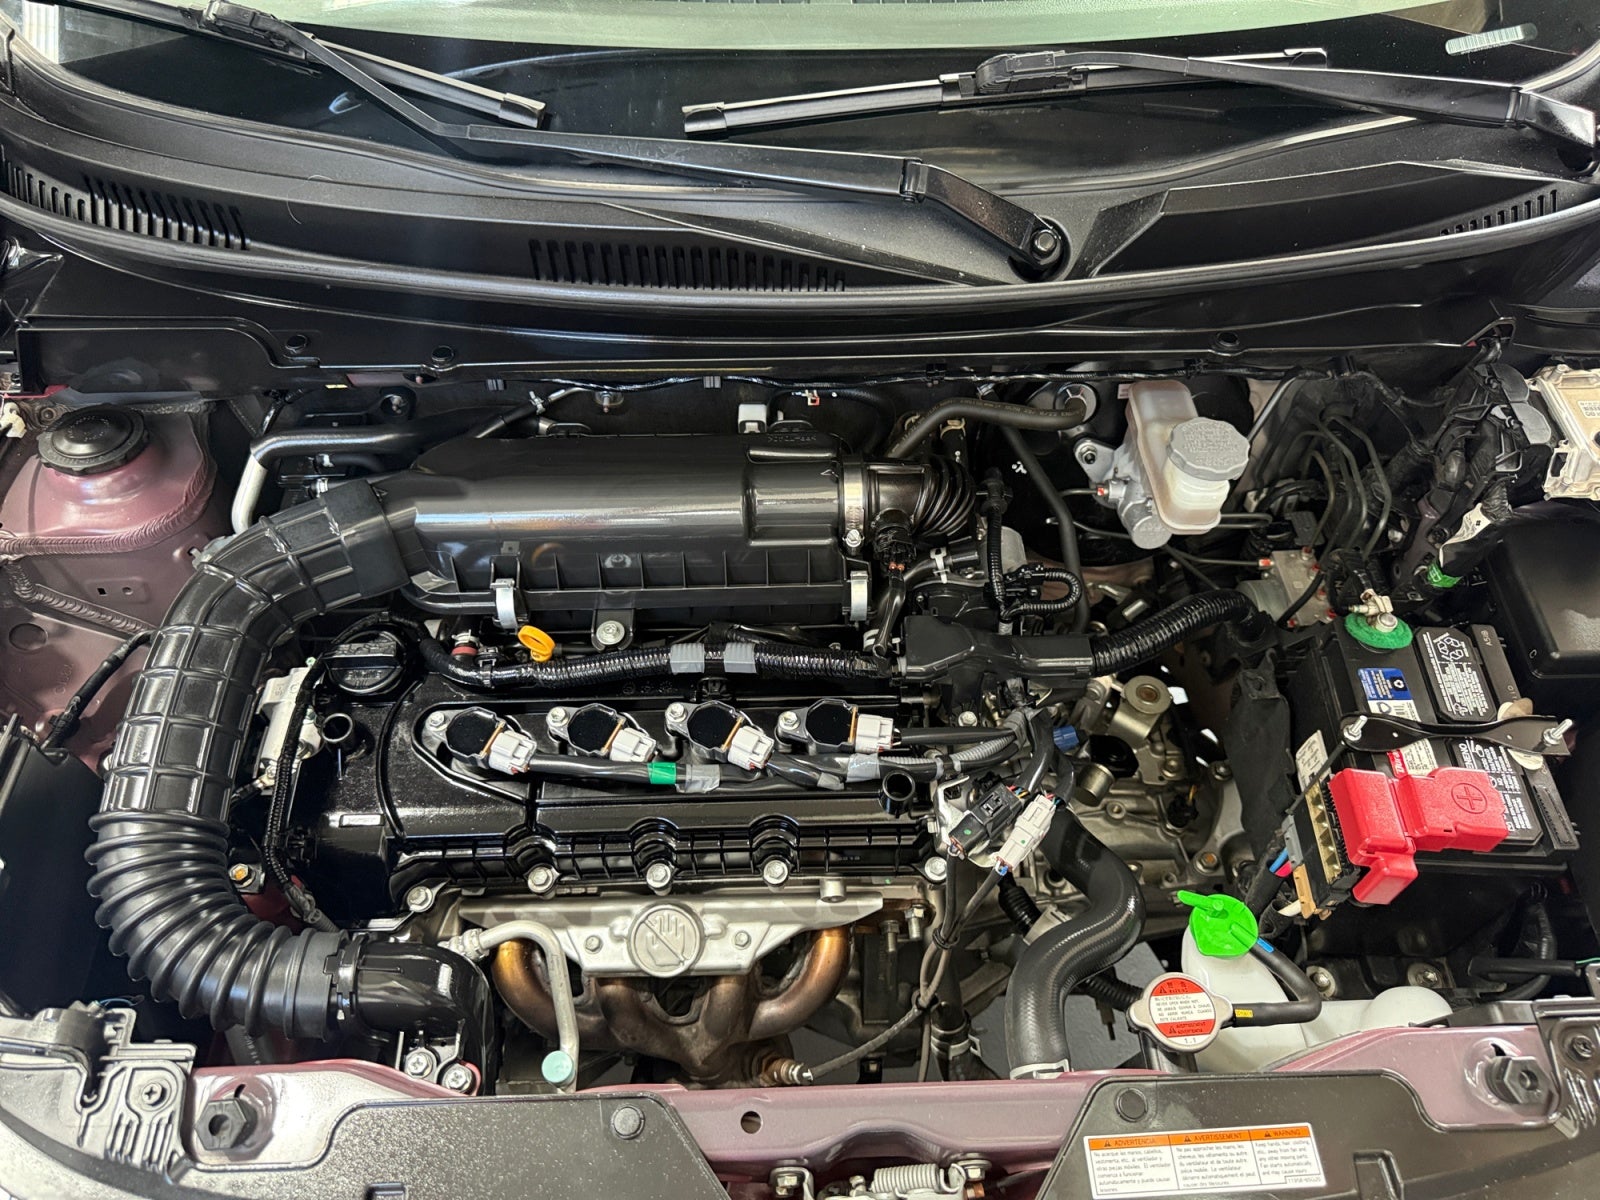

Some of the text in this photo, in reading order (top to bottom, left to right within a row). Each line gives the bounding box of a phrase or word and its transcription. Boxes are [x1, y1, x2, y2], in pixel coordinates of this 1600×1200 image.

[1459, 743, 1475, 770] ENENO
[1193, 1133, 1242, 1142] AVERTISSEMENT
[1114, 1138, 1157, 1147] ADVERTENCIA
